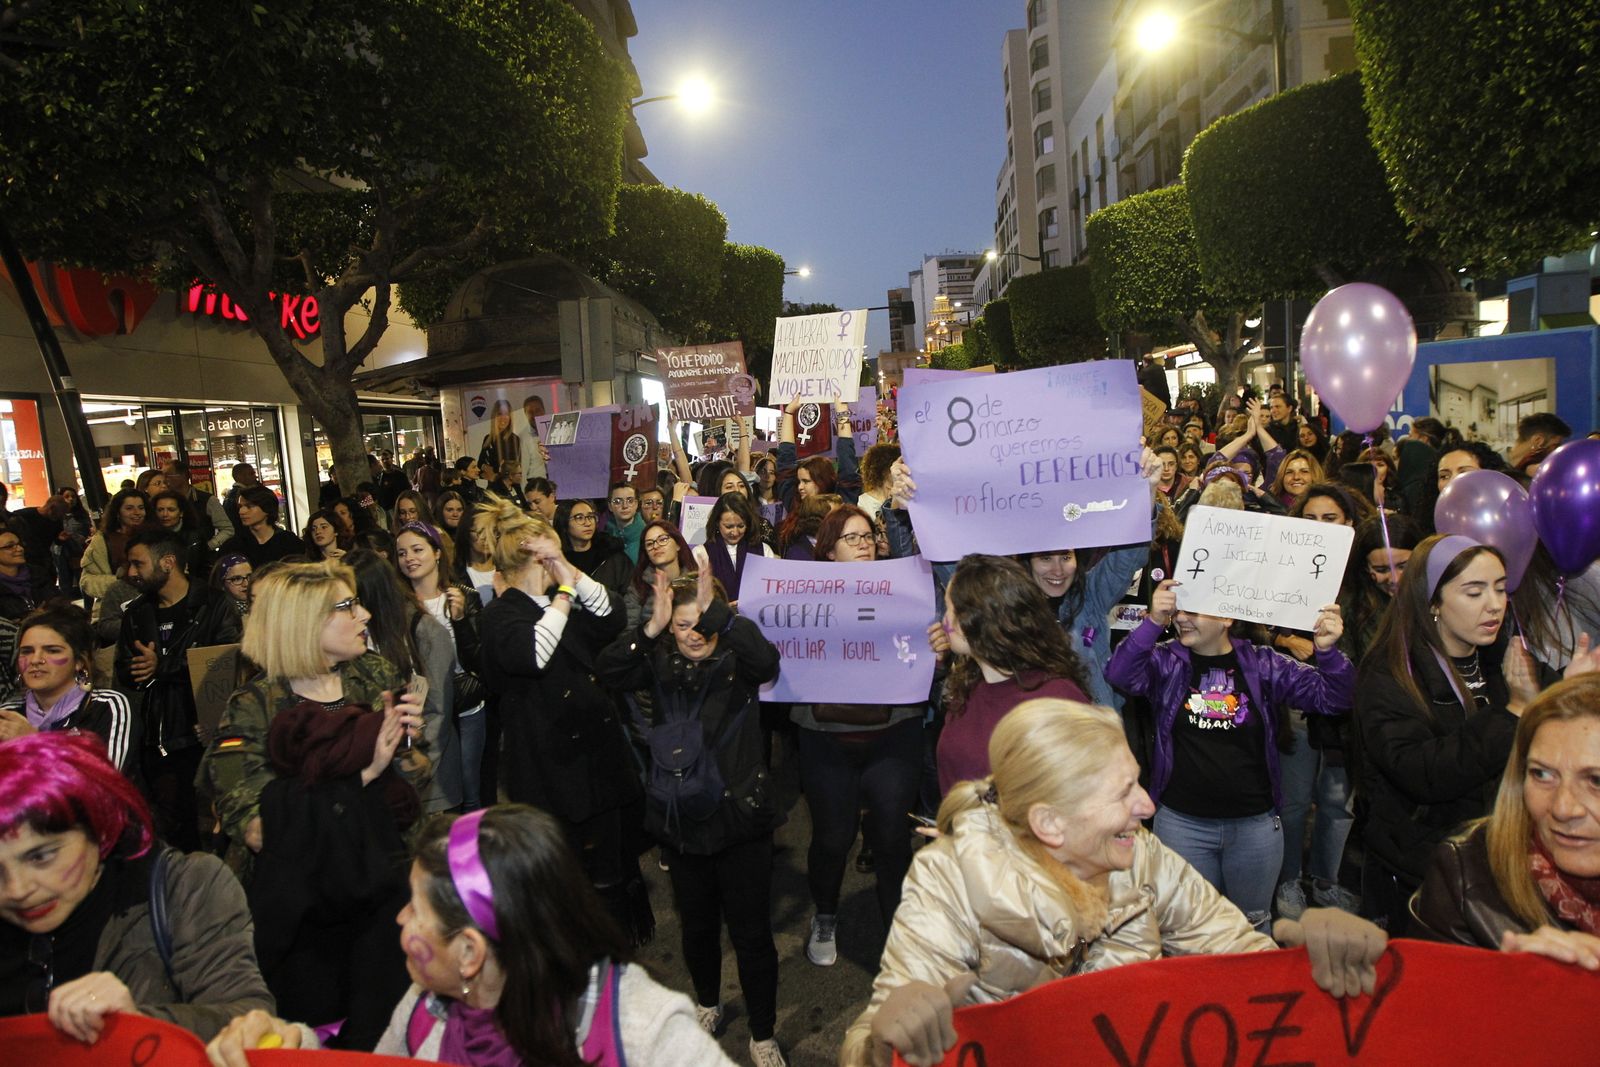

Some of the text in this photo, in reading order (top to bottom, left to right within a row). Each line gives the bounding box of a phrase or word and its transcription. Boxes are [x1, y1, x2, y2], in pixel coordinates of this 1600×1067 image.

[784, 317, 830, 347] PALABRAS
[668, 368, 703, 378] AYUDARME
[774, 347, 825, 374] MACHISTAS
[777, 377, 842, 399] VIOLETAS
[914, 393, 1003, 446] el 8 de
[979, 417, 1041, 438] marzo
[989, 434, 1084, 463] queremos
[1019, 450, 1139, 486] DERECHOS
[955, 481, 1043, 515] no flores
[1279, 530, 1327, 549] MUJER
[1277, 554, 1295, 568] LA
[761, 578, 894, 596] TRABAJAR IGUAL
[1213, 575, 1309, 607] REVOLUCIÓN
[758, 603, 839, 629] COBRAR
